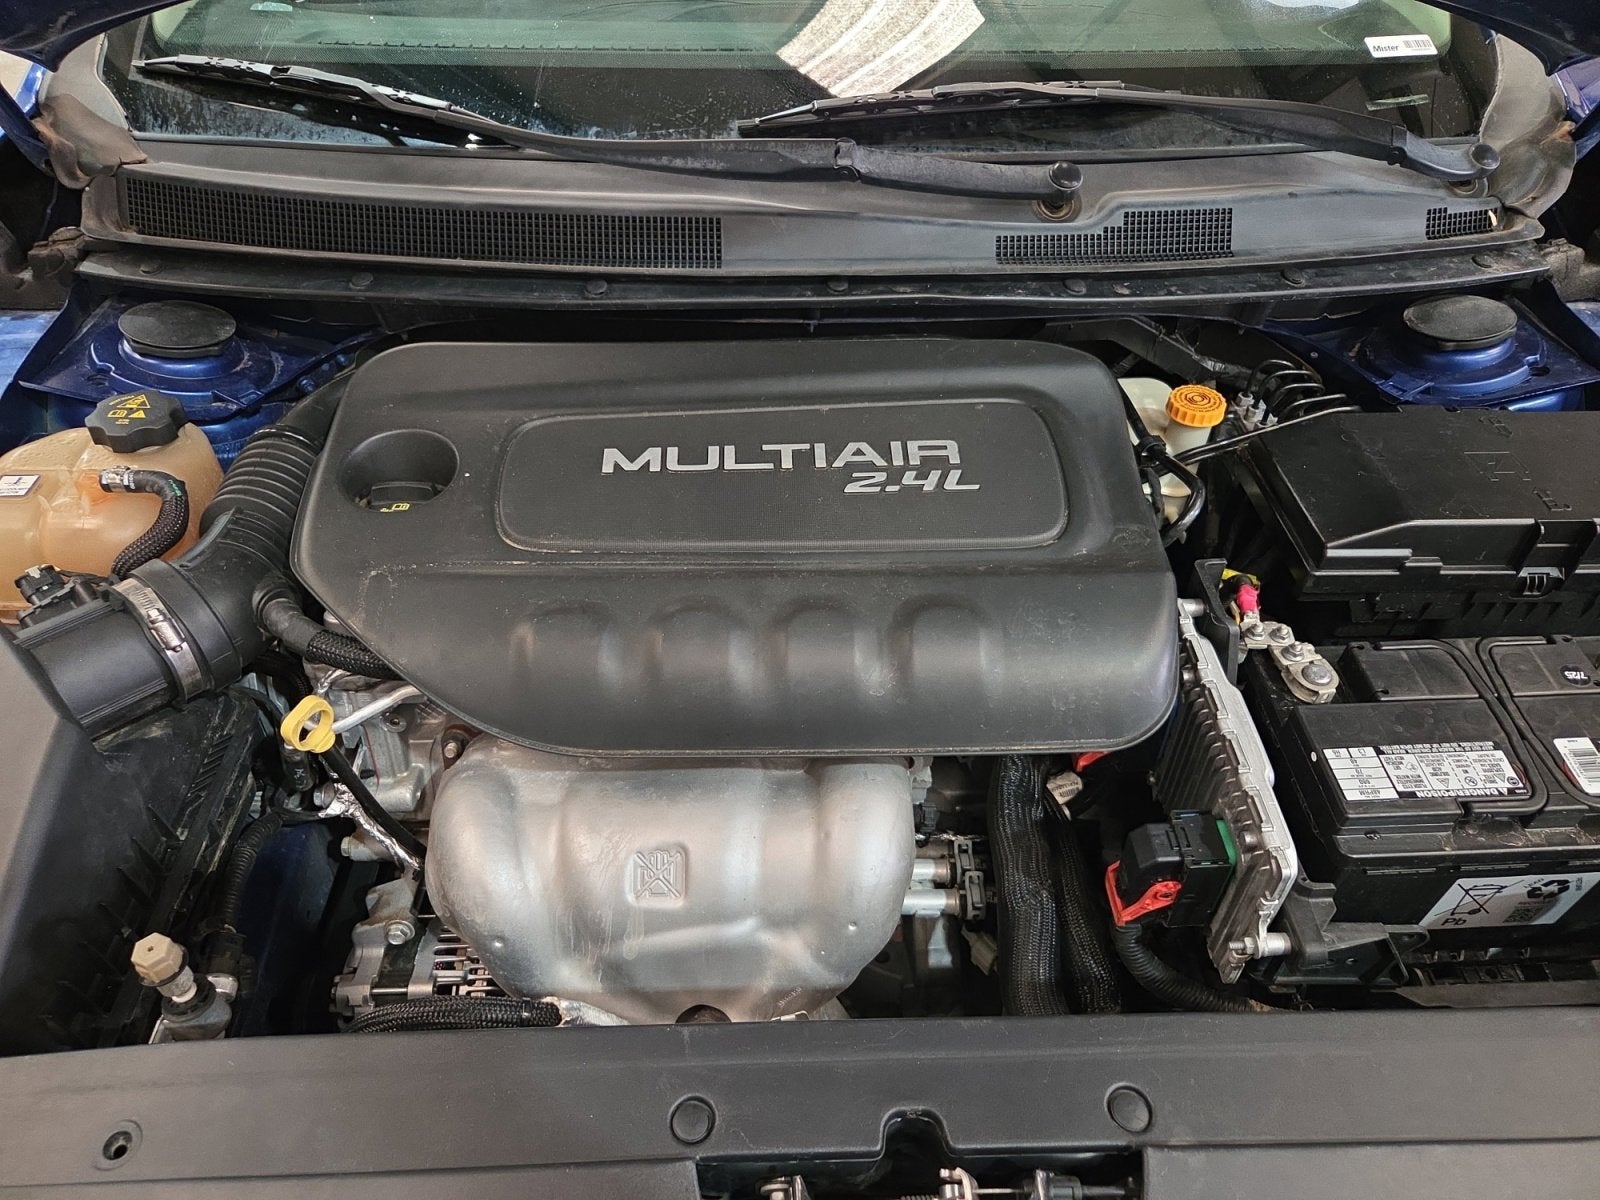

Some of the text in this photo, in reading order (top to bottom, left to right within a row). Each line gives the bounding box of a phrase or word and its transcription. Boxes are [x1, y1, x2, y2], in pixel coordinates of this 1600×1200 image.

[601, 439, 961, 474] MULTIAIR
[843, 469, 981, 493] 2.4L
[1564, 671, 1588, 680] 7/25
[1416, 788, 1500, 798] DANGER/POISON
[1441, 918, 1466, 926] Pb
